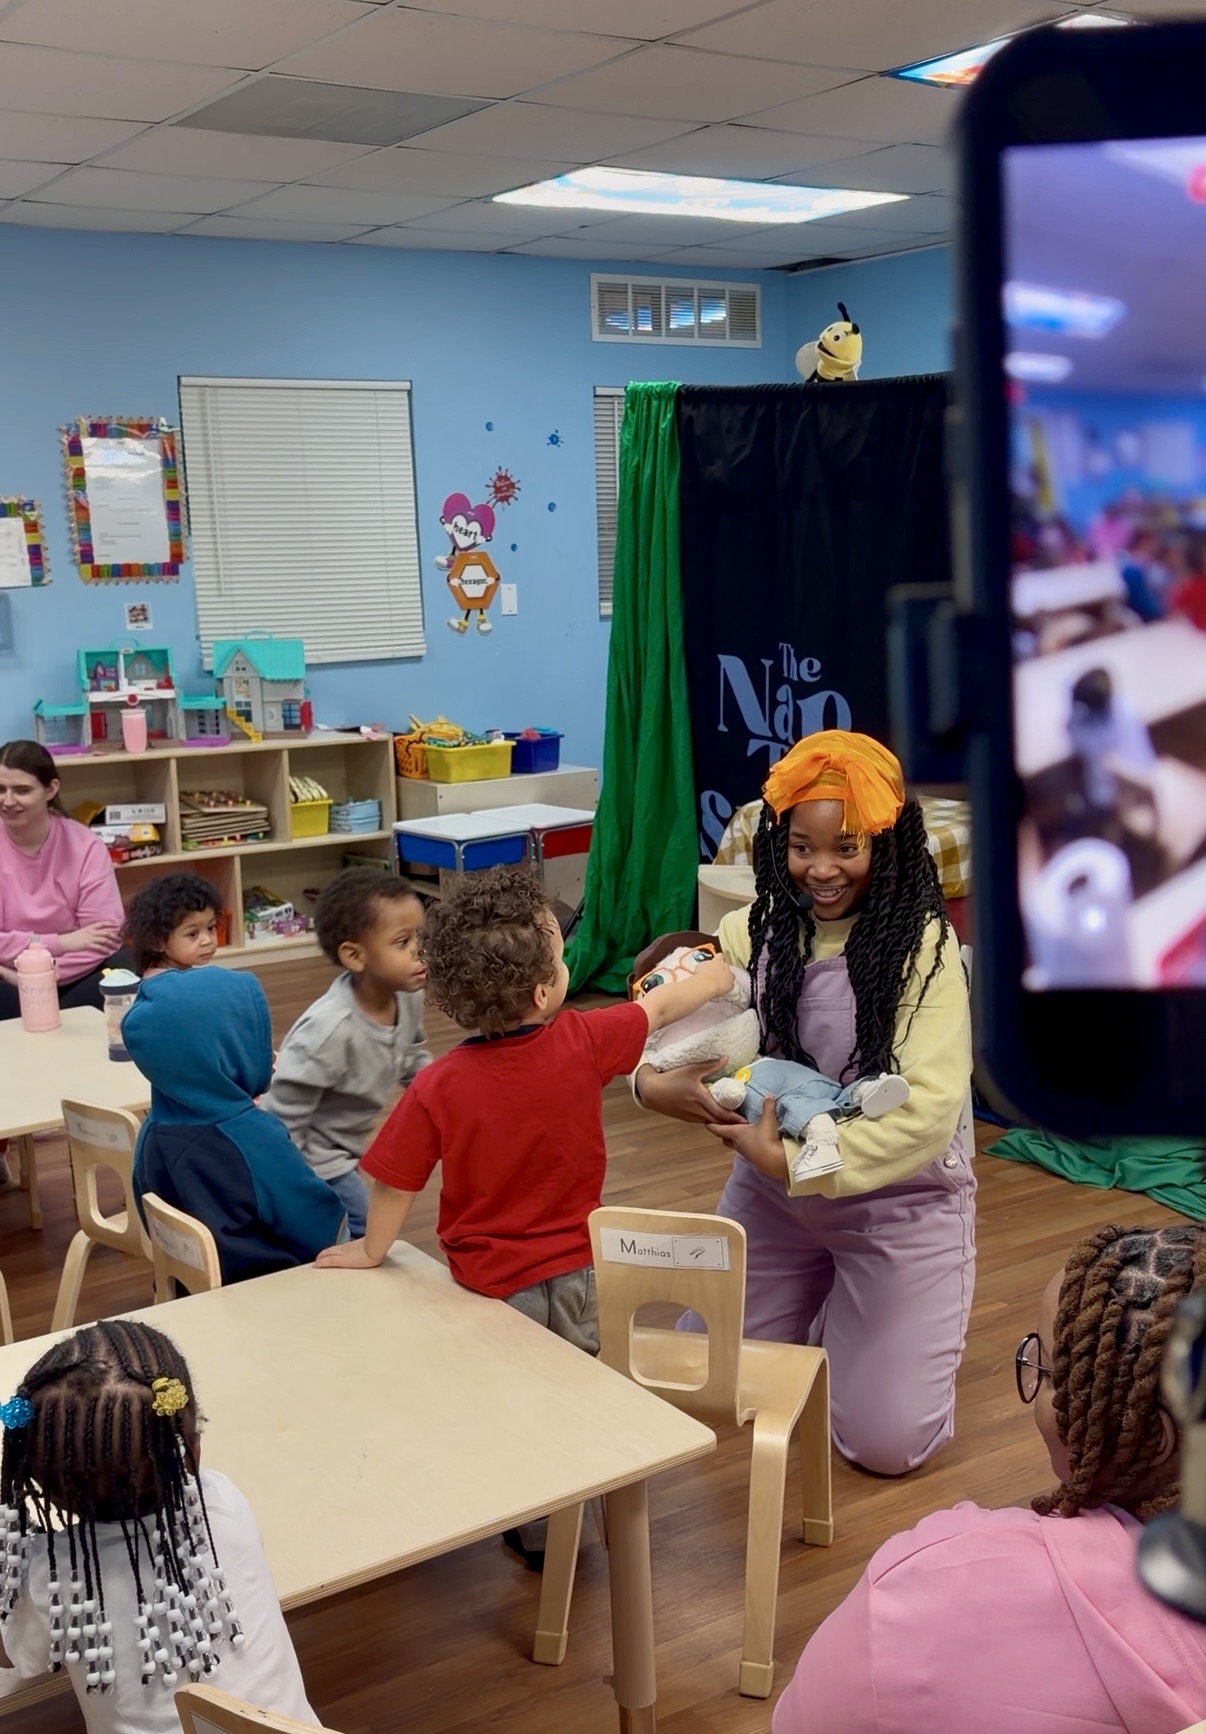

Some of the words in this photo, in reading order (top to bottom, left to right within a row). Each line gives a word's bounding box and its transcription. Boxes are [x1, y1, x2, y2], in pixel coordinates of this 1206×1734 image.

[453, 522, 477, 540] heart
[779, 642, 822, 682] The
[620, 1238, 671, 1258] Matthias
